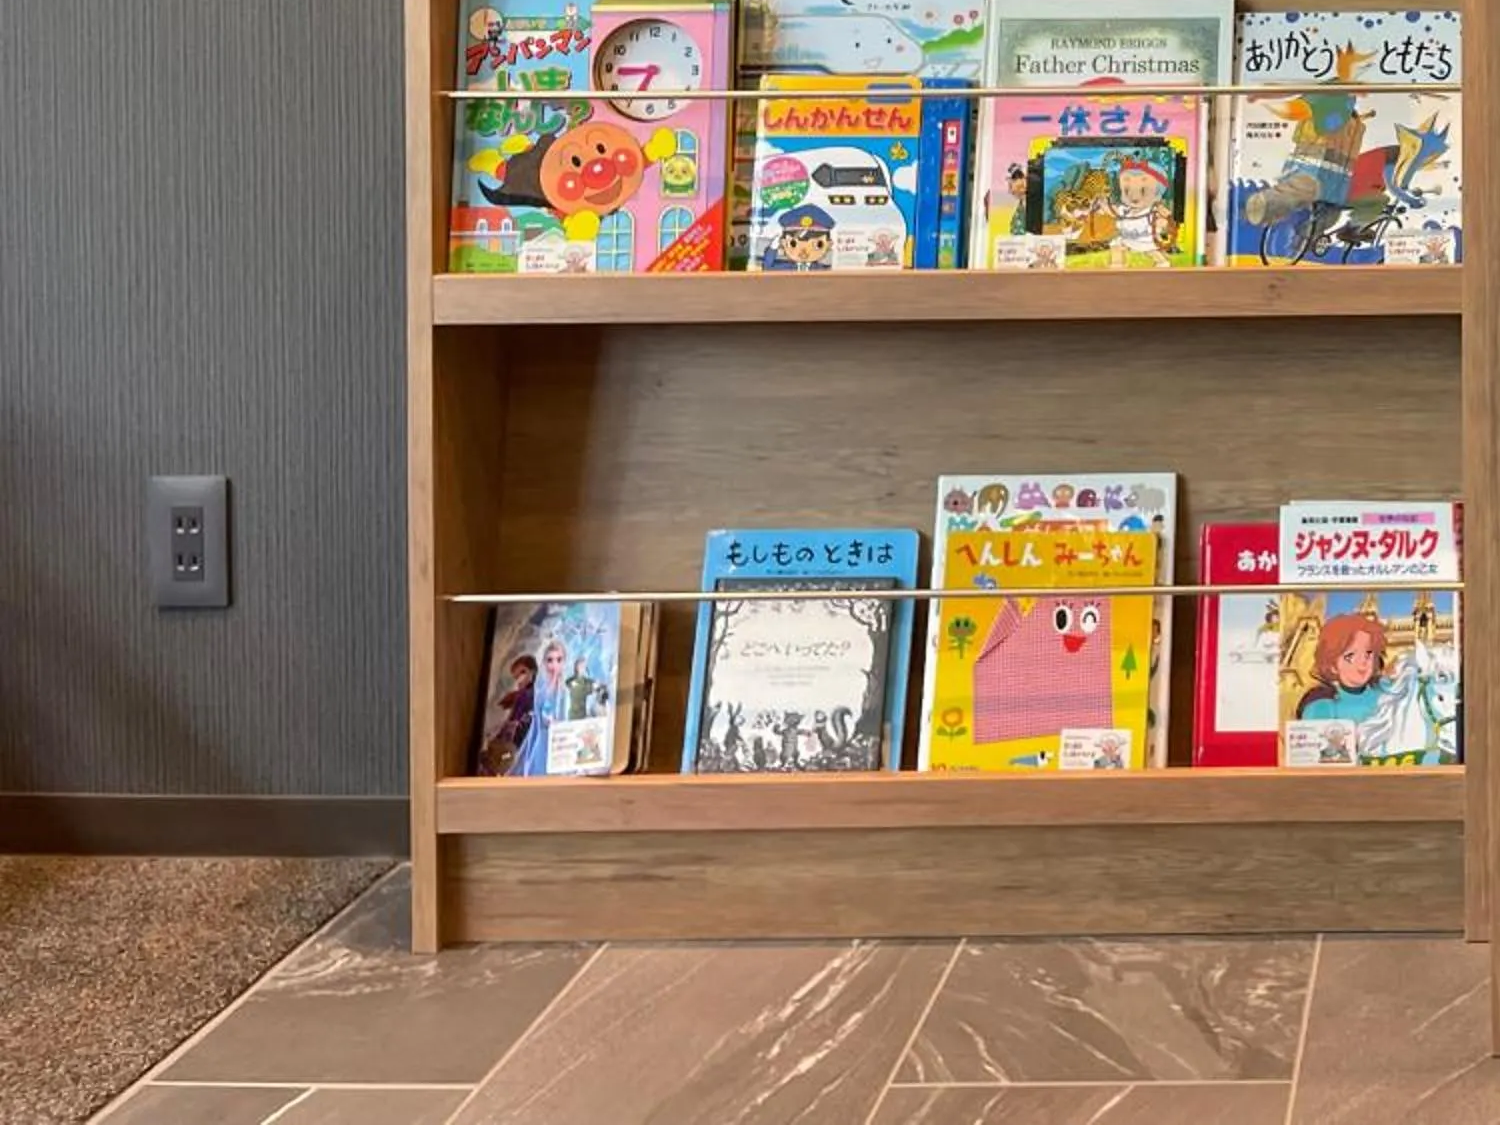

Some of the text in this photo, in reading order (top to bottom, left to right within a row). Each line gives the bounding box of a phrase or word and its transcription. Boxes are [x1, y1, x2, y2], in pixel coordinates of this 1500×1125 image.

[466, 29, 591, 75] アンパンマン
[1050, 37, 1167, 49] RAYMOND BRIGGS
[1245, 29, 1453, 80] ありがとう ともだち
[1015, 53, 1200, 75] Father Christmas
[763, 107, 912, 132] しんかんせん
[1019, 104, 1169, 136] 一休さん
[726, 540, 895, 566] もしもの ときは
[956, 540, 1043, 567] へんしん
[1294, 528, 1440, 562] ジャンヌ・ダルク
